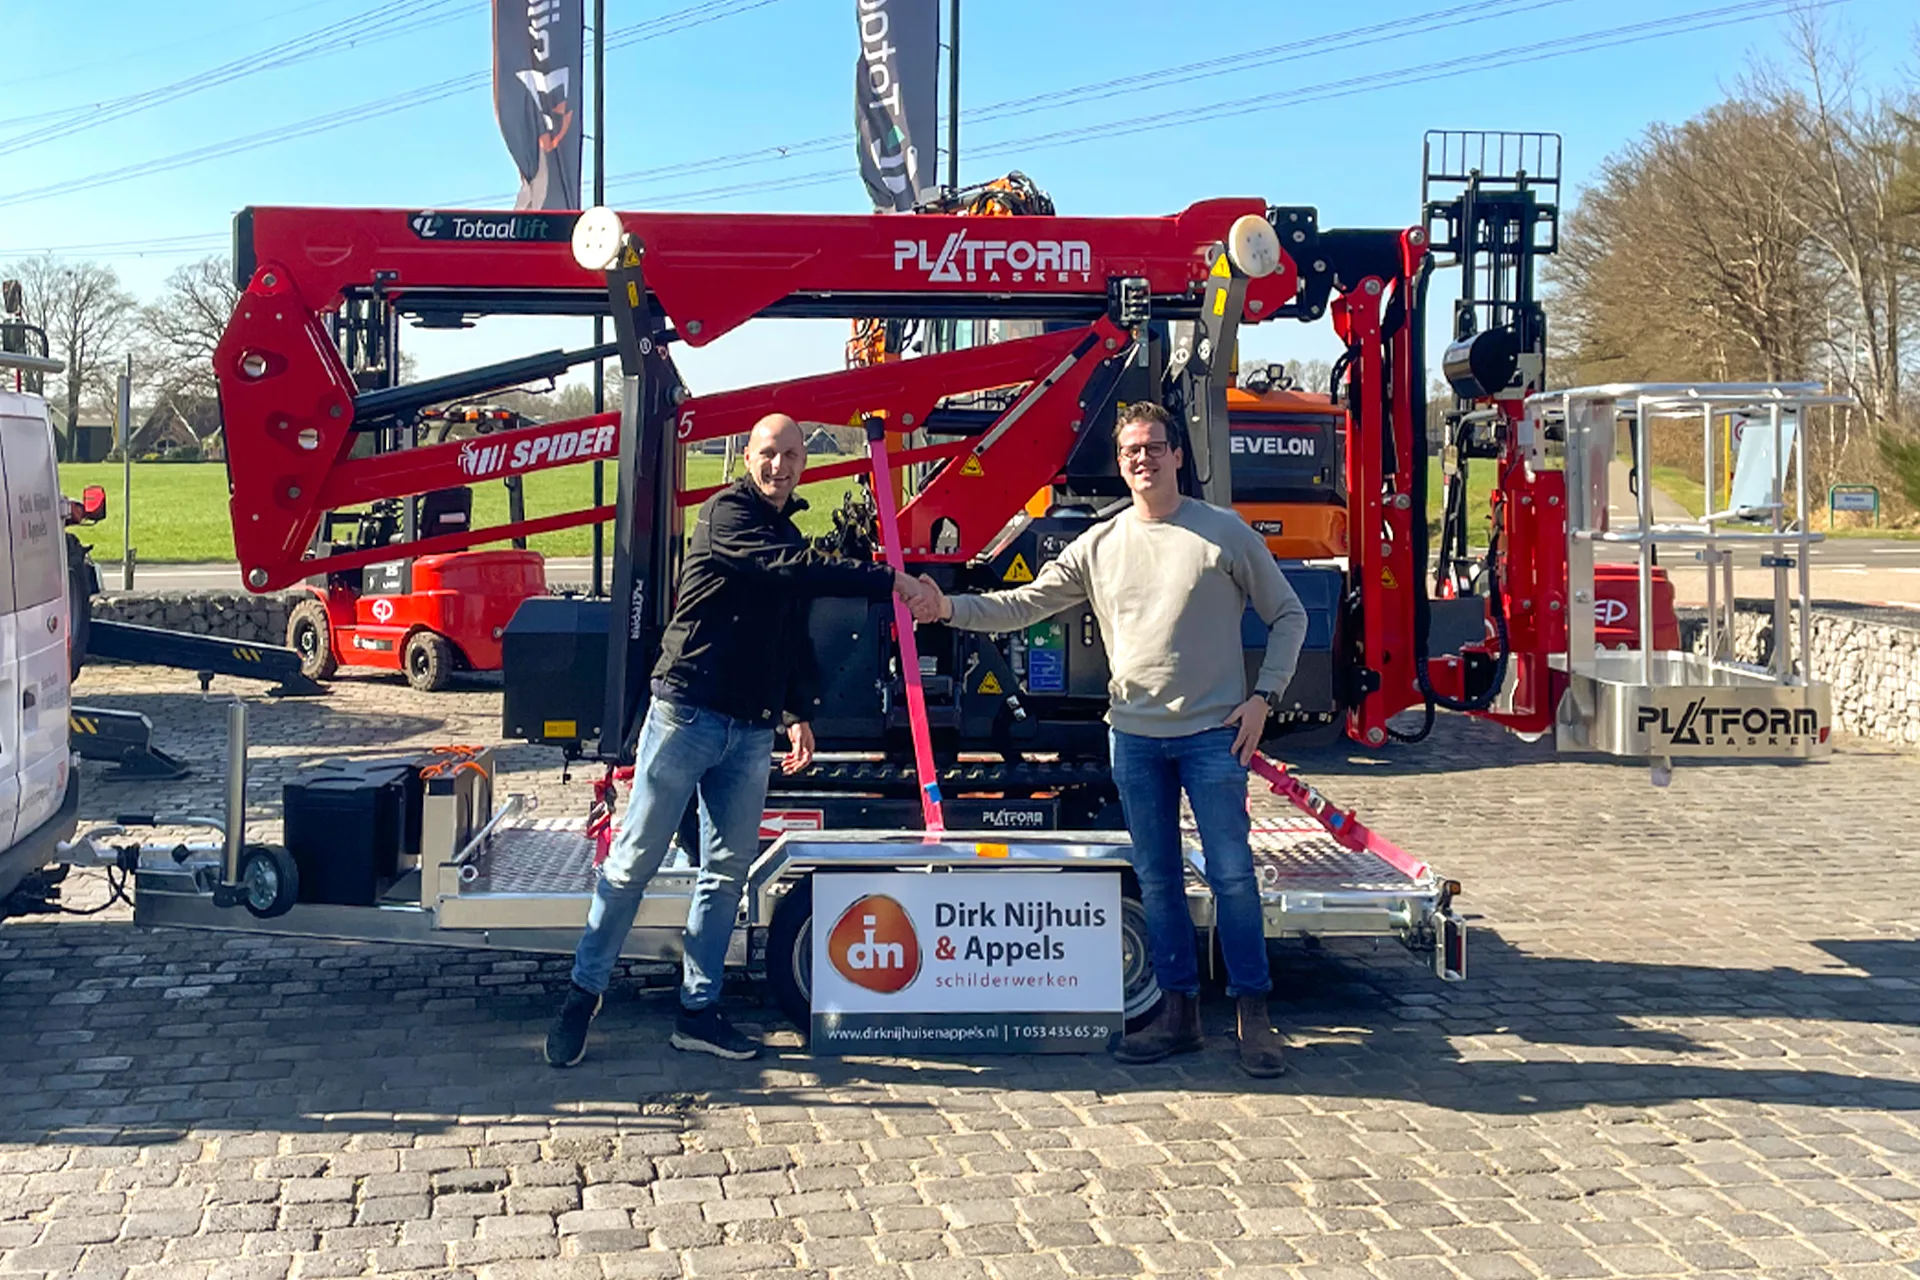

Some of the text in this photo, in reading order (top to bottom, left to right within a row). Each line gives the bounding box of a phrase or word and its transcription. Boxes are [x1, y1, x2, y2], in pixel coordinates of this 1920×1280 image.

[453, 217, 549, 239] Totaallift
[894, 228, 1091, 282] PLATFORM
[966, 271, 1091, 282] BASKET
[510, 424, 616, 468] SPIDER
[1230, 436, 1315, 457] EVELON
[1638, 697, 1818, 745] PLATFORM
[1706, 736, 1818, 745] BASKET
[935, 901, 1107, 934] Dirk Nijhuis
[935, 934, 1066, 967] & Appels
[935, 973, 1079, 988] schilderwerken
[827, 1025, 999, 1043] www.dirknijhuisenappels.nl
[1023, 1026, 1047, 1038] 053
[1048, 1026, 1073, 1038] 435
[1074, 1026, 1091, 1038] 65
[1092, 1026, 1109, 1038] 29
